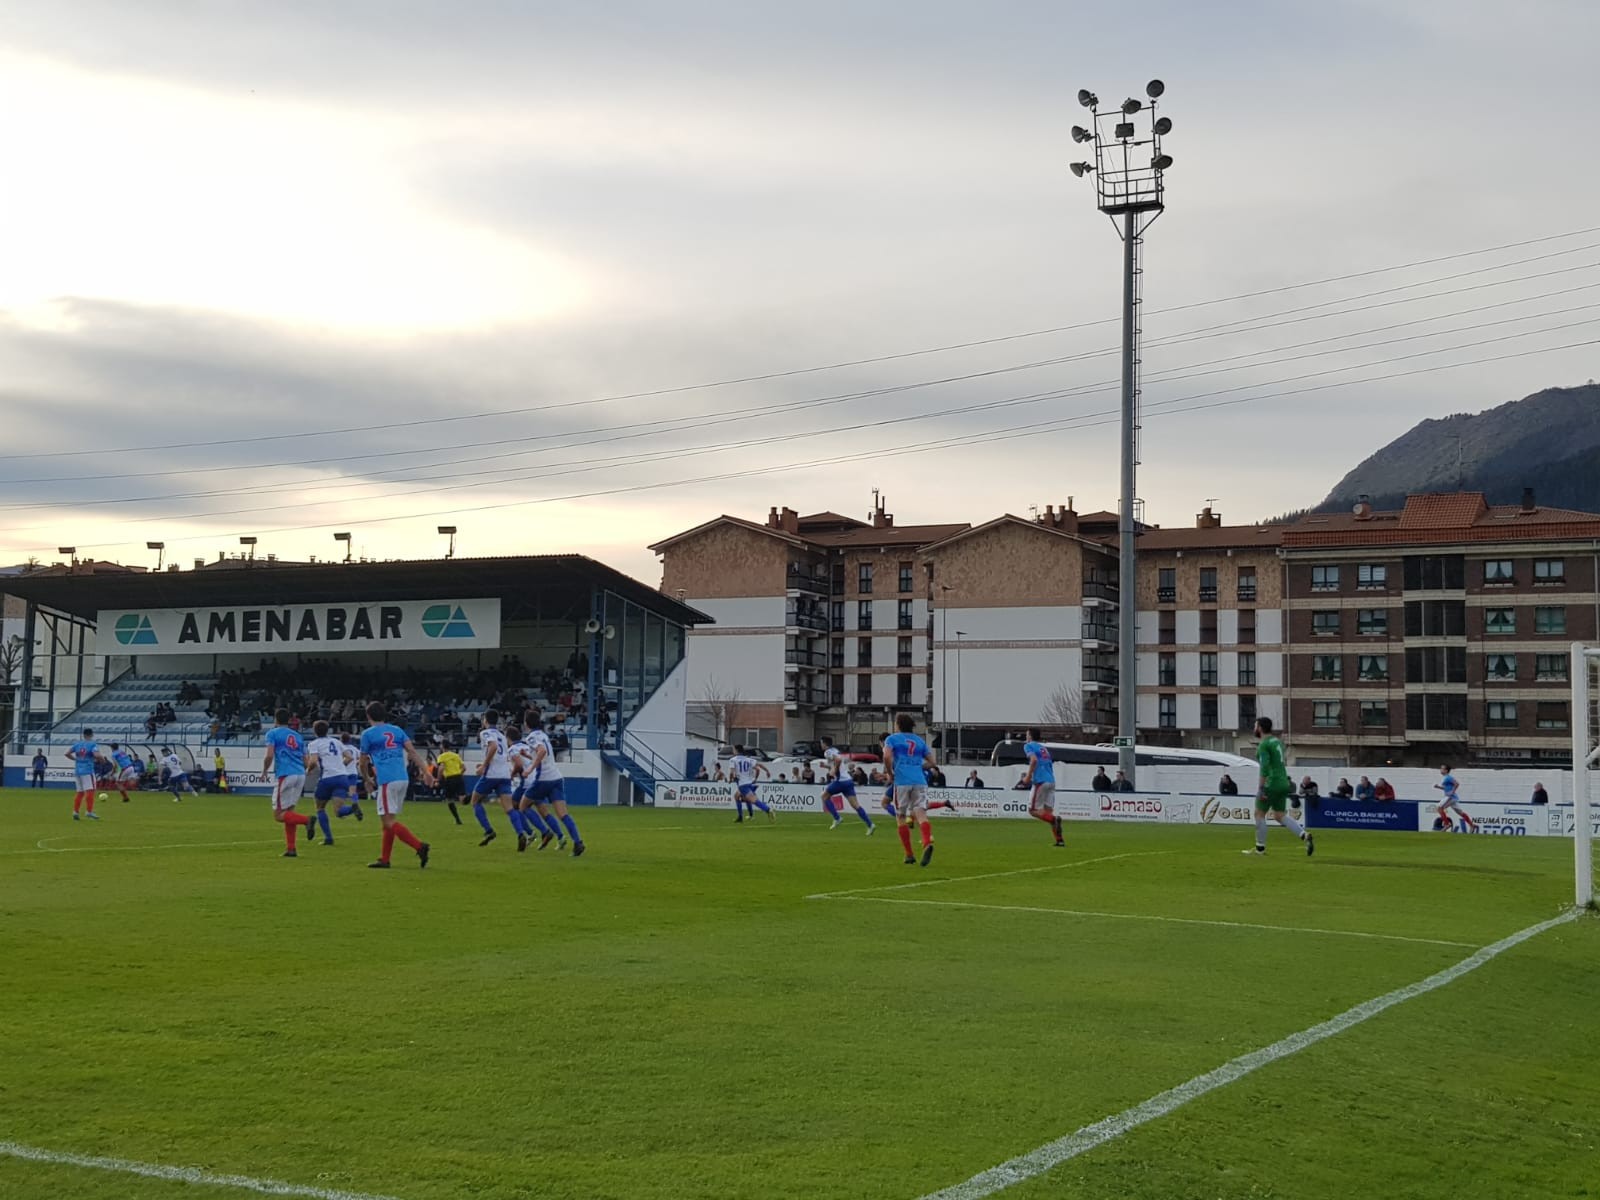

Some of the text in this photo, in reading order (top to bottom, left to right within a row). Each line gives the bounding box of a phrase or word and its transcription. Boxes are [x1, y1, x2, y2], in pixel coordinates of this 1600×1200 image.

[178, 605, 403, 644] AMENABAR
[286, 734, 298, 750] 4
[383, 732, 398, 749] 2
[906, 739, 916, 756] 7
[329, 741, 338, 756] 4
[170, 757, 178, 766] 9
[738, 761, 750, 773] 10
[762, 785, 785, 794] grupo
[762, 794, 815, 806] LAZKANO
